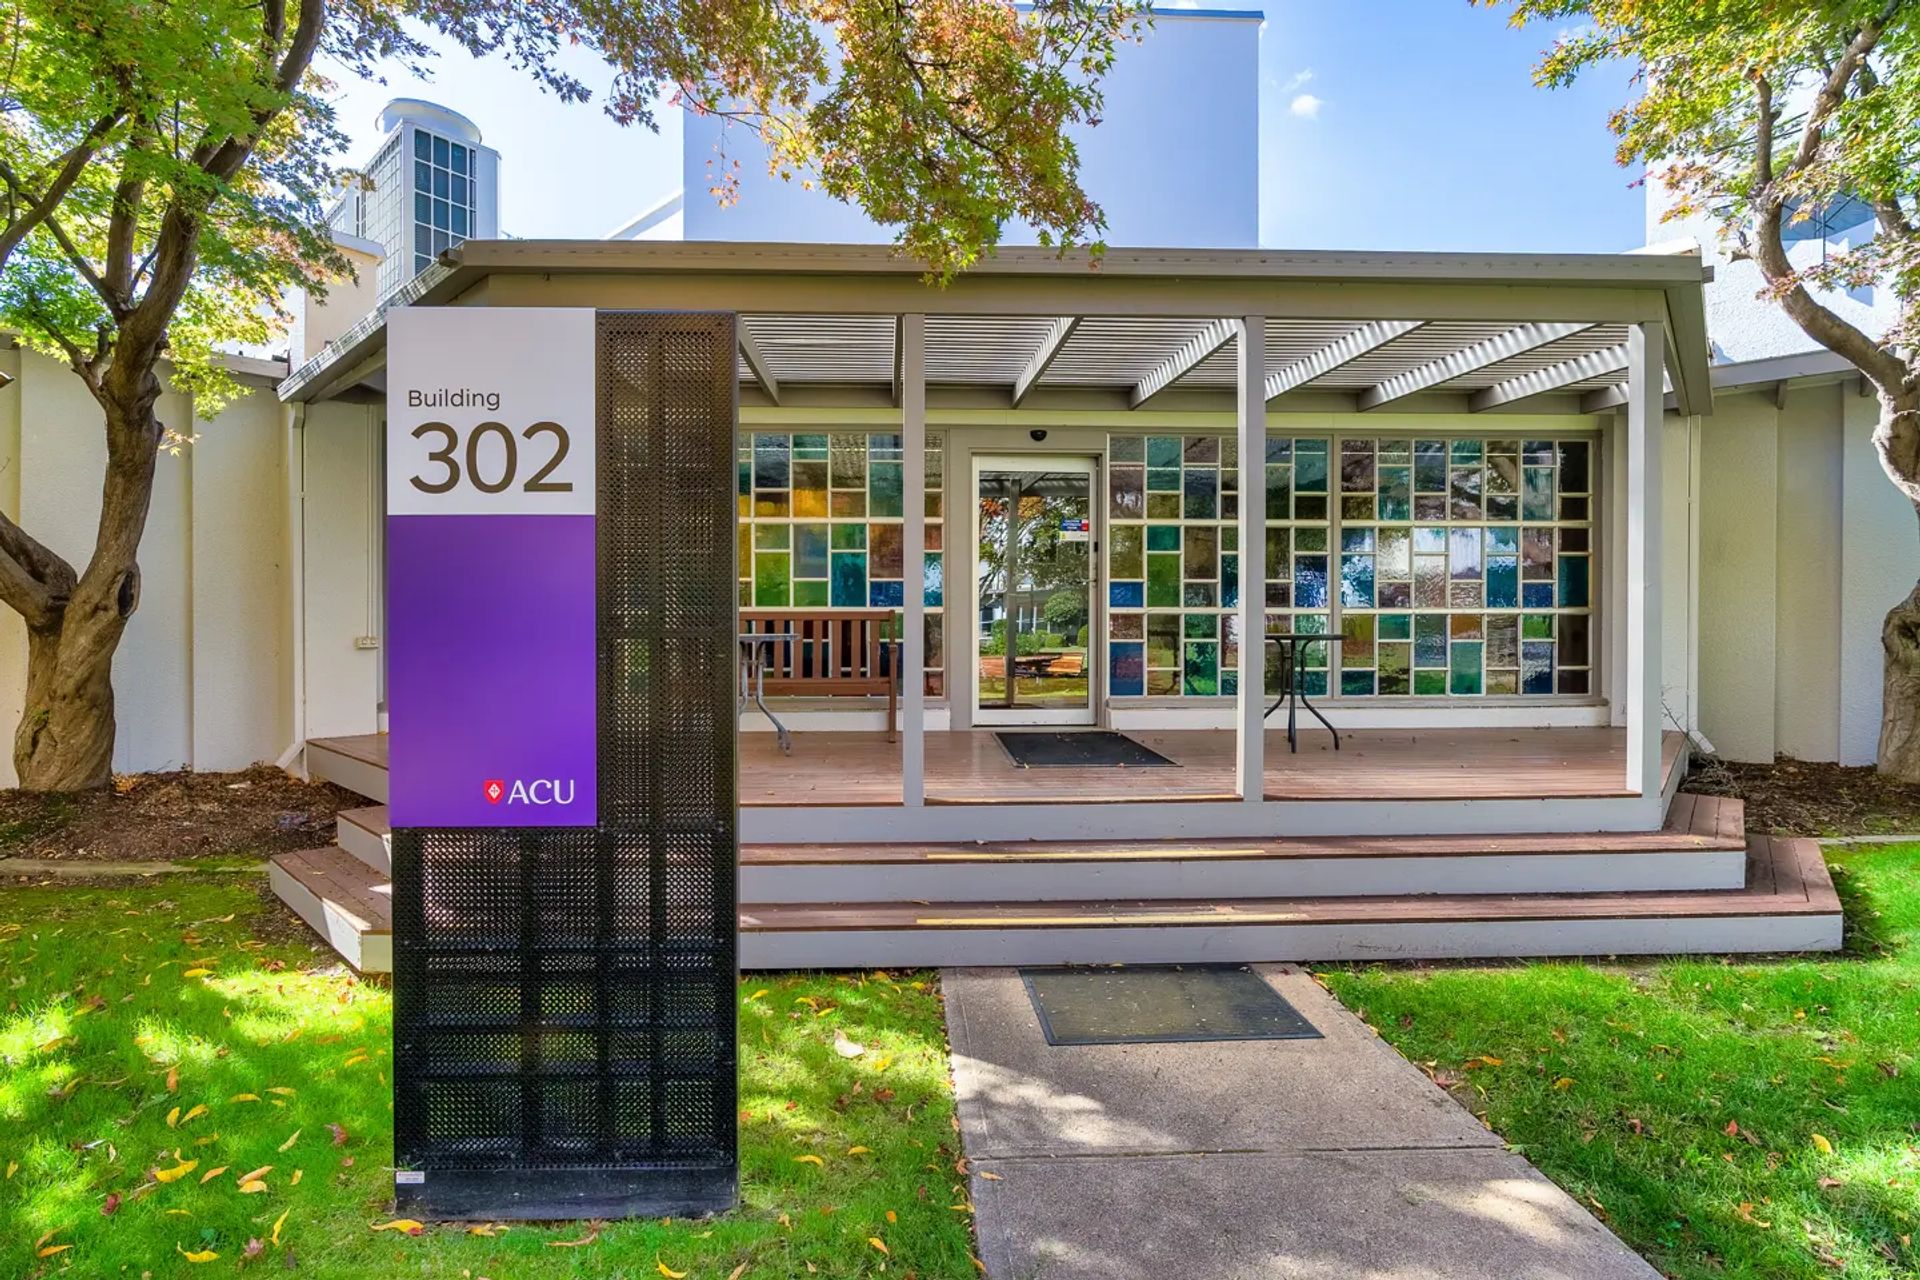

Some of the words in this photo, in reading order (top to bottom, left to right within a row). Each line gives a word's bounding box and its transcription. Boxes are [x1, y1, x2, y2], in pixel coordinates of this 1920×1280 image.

[408, 389, 500, 411] Building
[409, 421, 573, 494] 302
[507, 779, 575, 805] ACU
